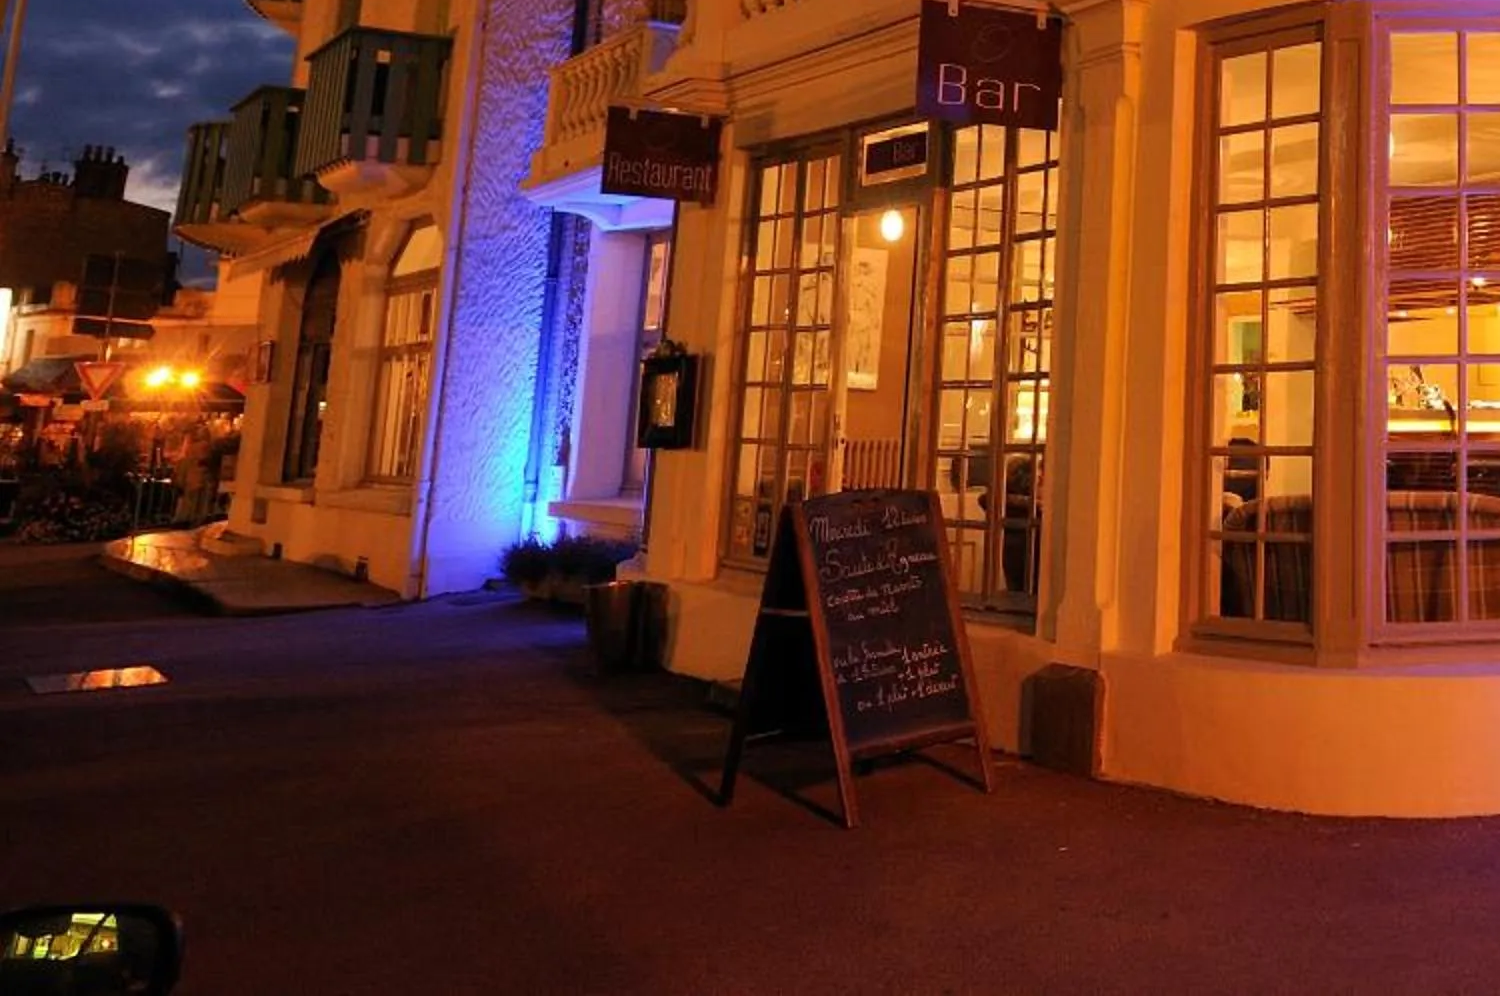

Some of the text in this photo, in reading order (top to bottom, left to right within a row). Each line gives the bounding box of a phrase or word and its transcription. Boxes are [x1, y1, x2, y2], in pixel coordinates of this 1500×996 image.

[936, 63, 1041, 111] Bar
[892, 140, 917, 163] Bar
[606, 153, 713, 192] Restaurant
